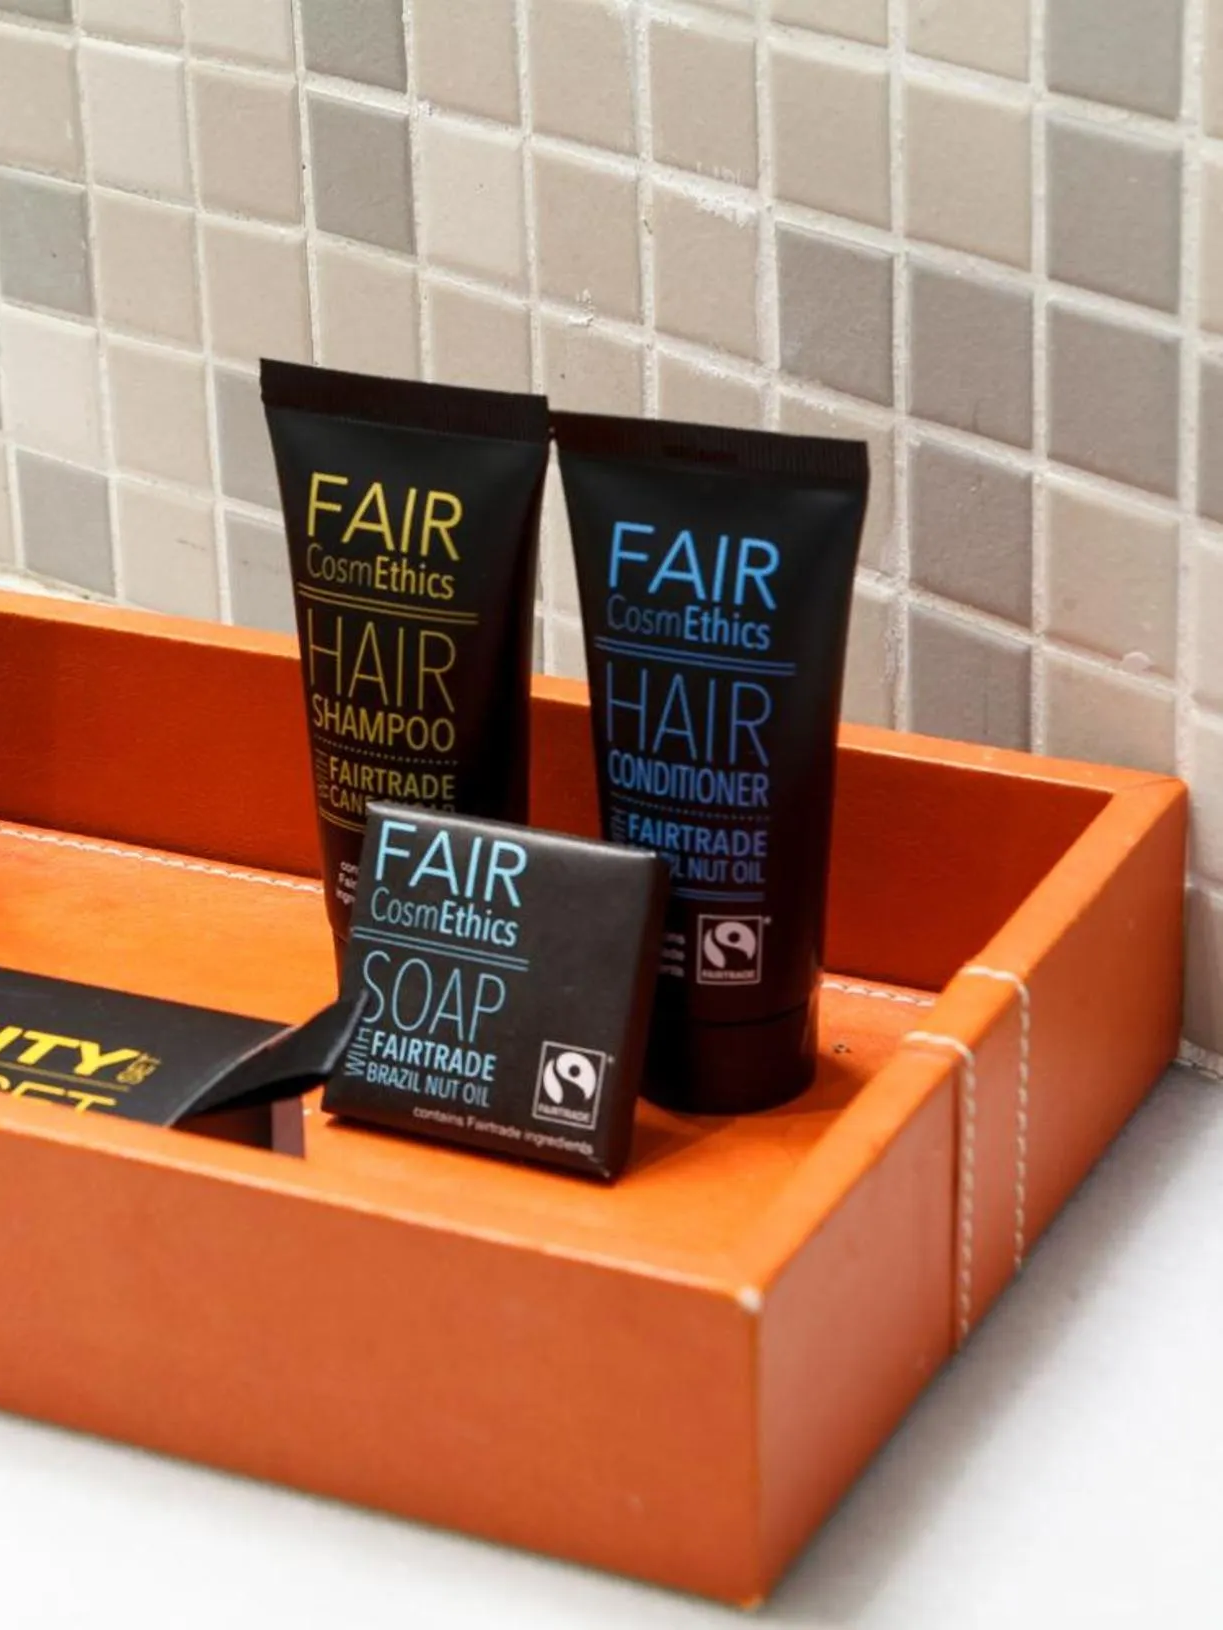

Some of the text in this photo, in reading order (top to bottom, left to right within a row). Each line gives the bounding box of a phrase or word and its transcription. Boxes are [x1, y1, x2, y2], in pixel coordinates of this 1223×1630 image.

[306, 472, 464, 562] FAIR
[306, 542, 455, 601] CosmEthics
[609, 521, 780, 611] FAIR
[606, 593, 771, 652] CosmEthics
[306, 607, 457, 714] HAIR
[311, 692, 456, 753] SHAMPOO
[606, 660, 771, 768] HAIR
[329, 755, 456, 800] FAIRTRADE
[607, 748, 770, 808] CONDITIONER
[375, 819, 529, 909] FAIR
[628, 812, 768, 858] FAIRTRADE
[687, 858, 729, 883] NUT
[731, 859, 766, 885] OIL
[371, 886, 520, 949] CosmEthics
[362, 949, 507, 1044] SOAP
[365, 1061, 491, 1108] BRAZIL NUT OIL
[370, 1030, 498, 1082] FAIRTRADE
[412, 1105, 465, 1128] contains
[466, 1114, 522, 1141] Fairtrade
